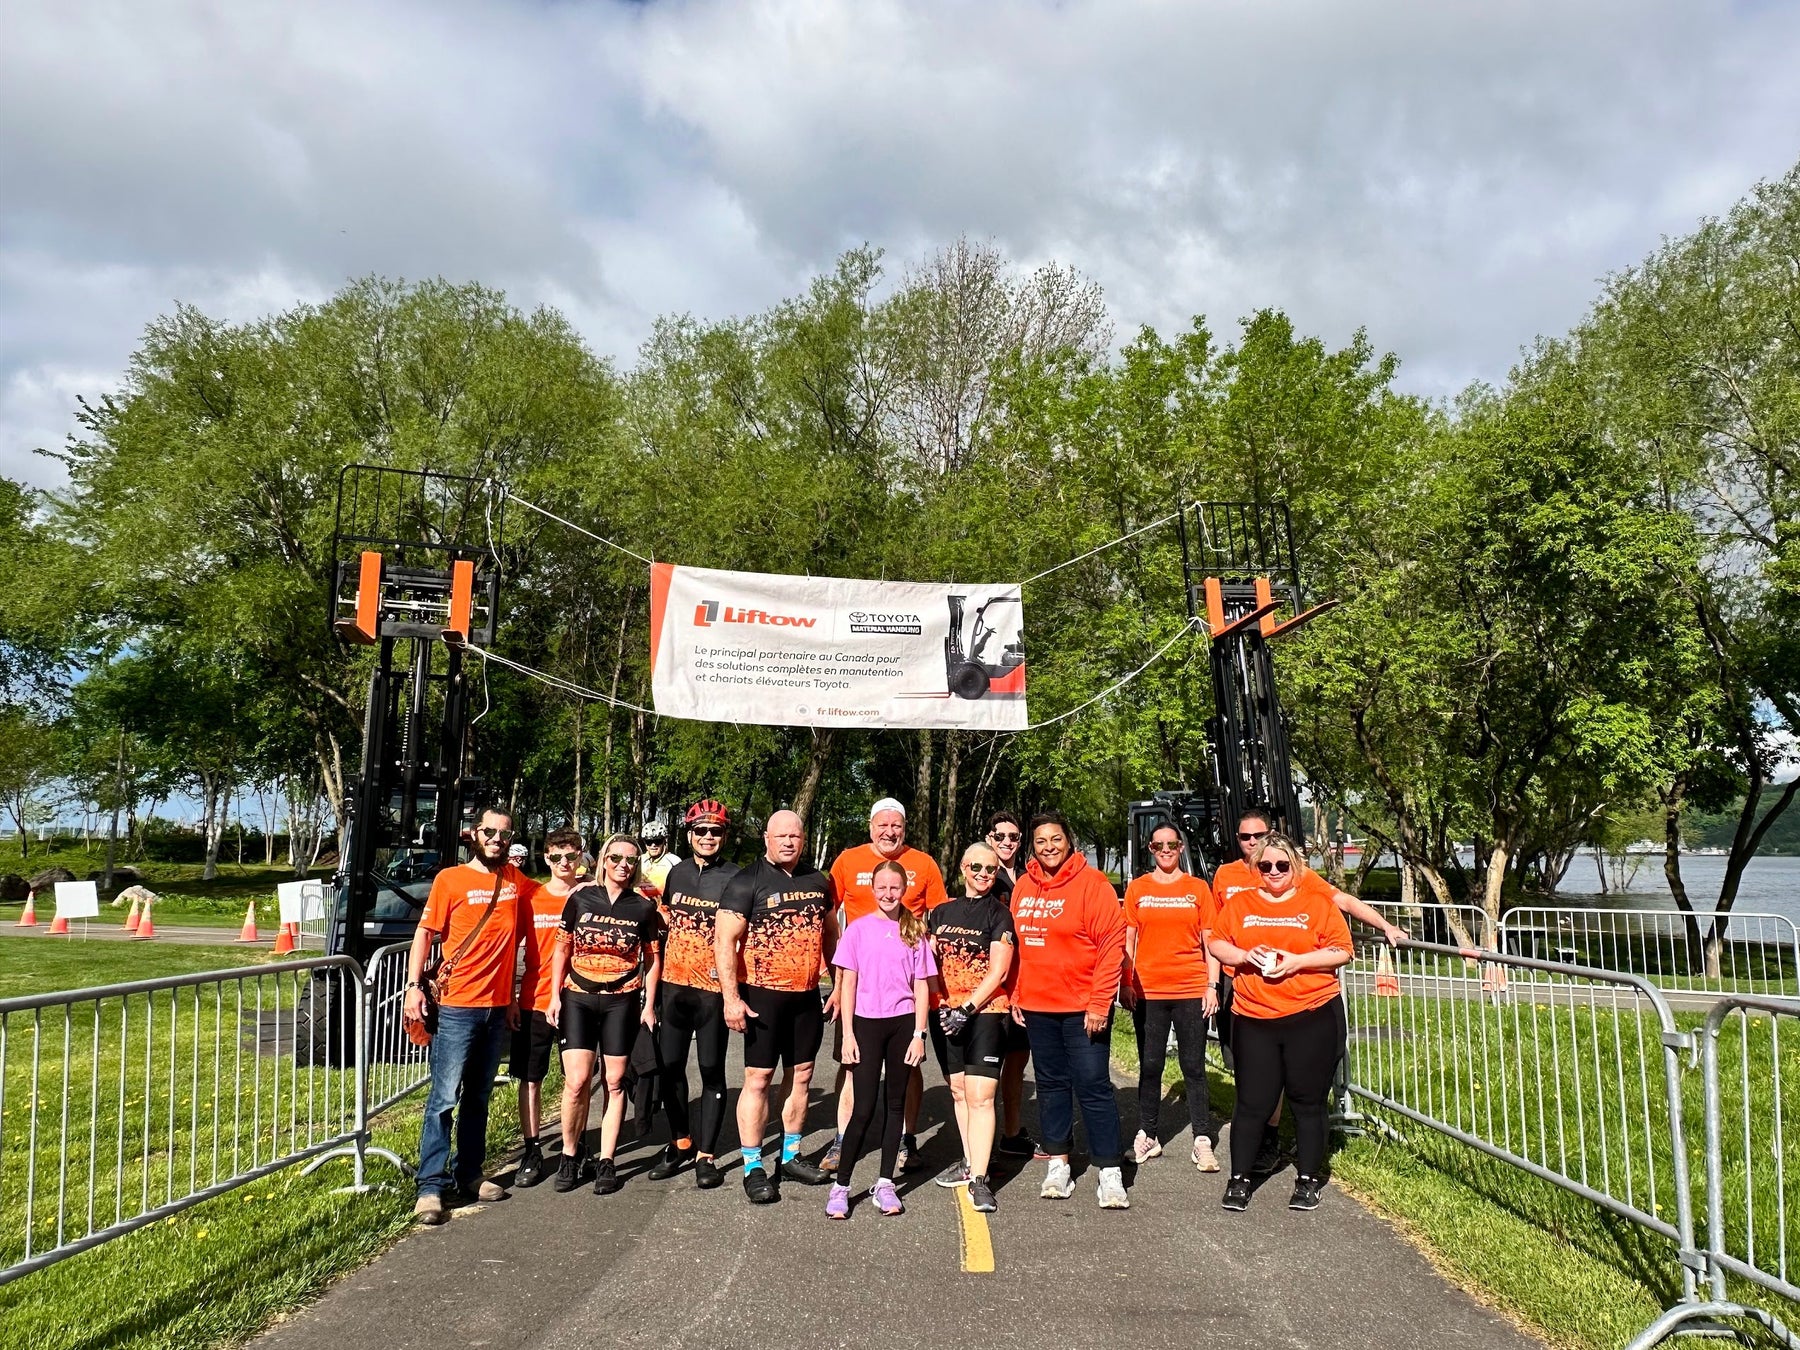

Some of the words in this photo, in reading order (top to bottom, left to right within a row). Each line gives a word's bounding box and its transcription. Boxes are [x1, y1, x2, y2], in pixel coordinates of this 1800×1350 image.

[723, 606, 817, 628] Liftow
[869, 613, 921, 623] TOYOTA
[852, 625, 886, 633] MATERIAL
[886, 626, 920, 634] HANDLING
[694, 645, 708, 655] Le
[709, 647, 757, 660] principal
[758, 650, 817, 661] partenaire
[834, 652, 875, 662] Canada
[875, 655, 901, 666] pour
[694, 658, 715, 669] des
[716, 660, 765, 673] solutions
[766, 664, 822, 676] complètes
[823, 667, 837, 676] en
[839, 668, 904, 677] manutention
[695, 673, 707, 682] et
[709, 673, 754, 685] chariots
[755, 676, 811, 688] élévateurs
[813, 678, 852, 691] Toyota.
[592, 914, 639, 927] Liftow
[944, 925, 982, 936] Liftow
